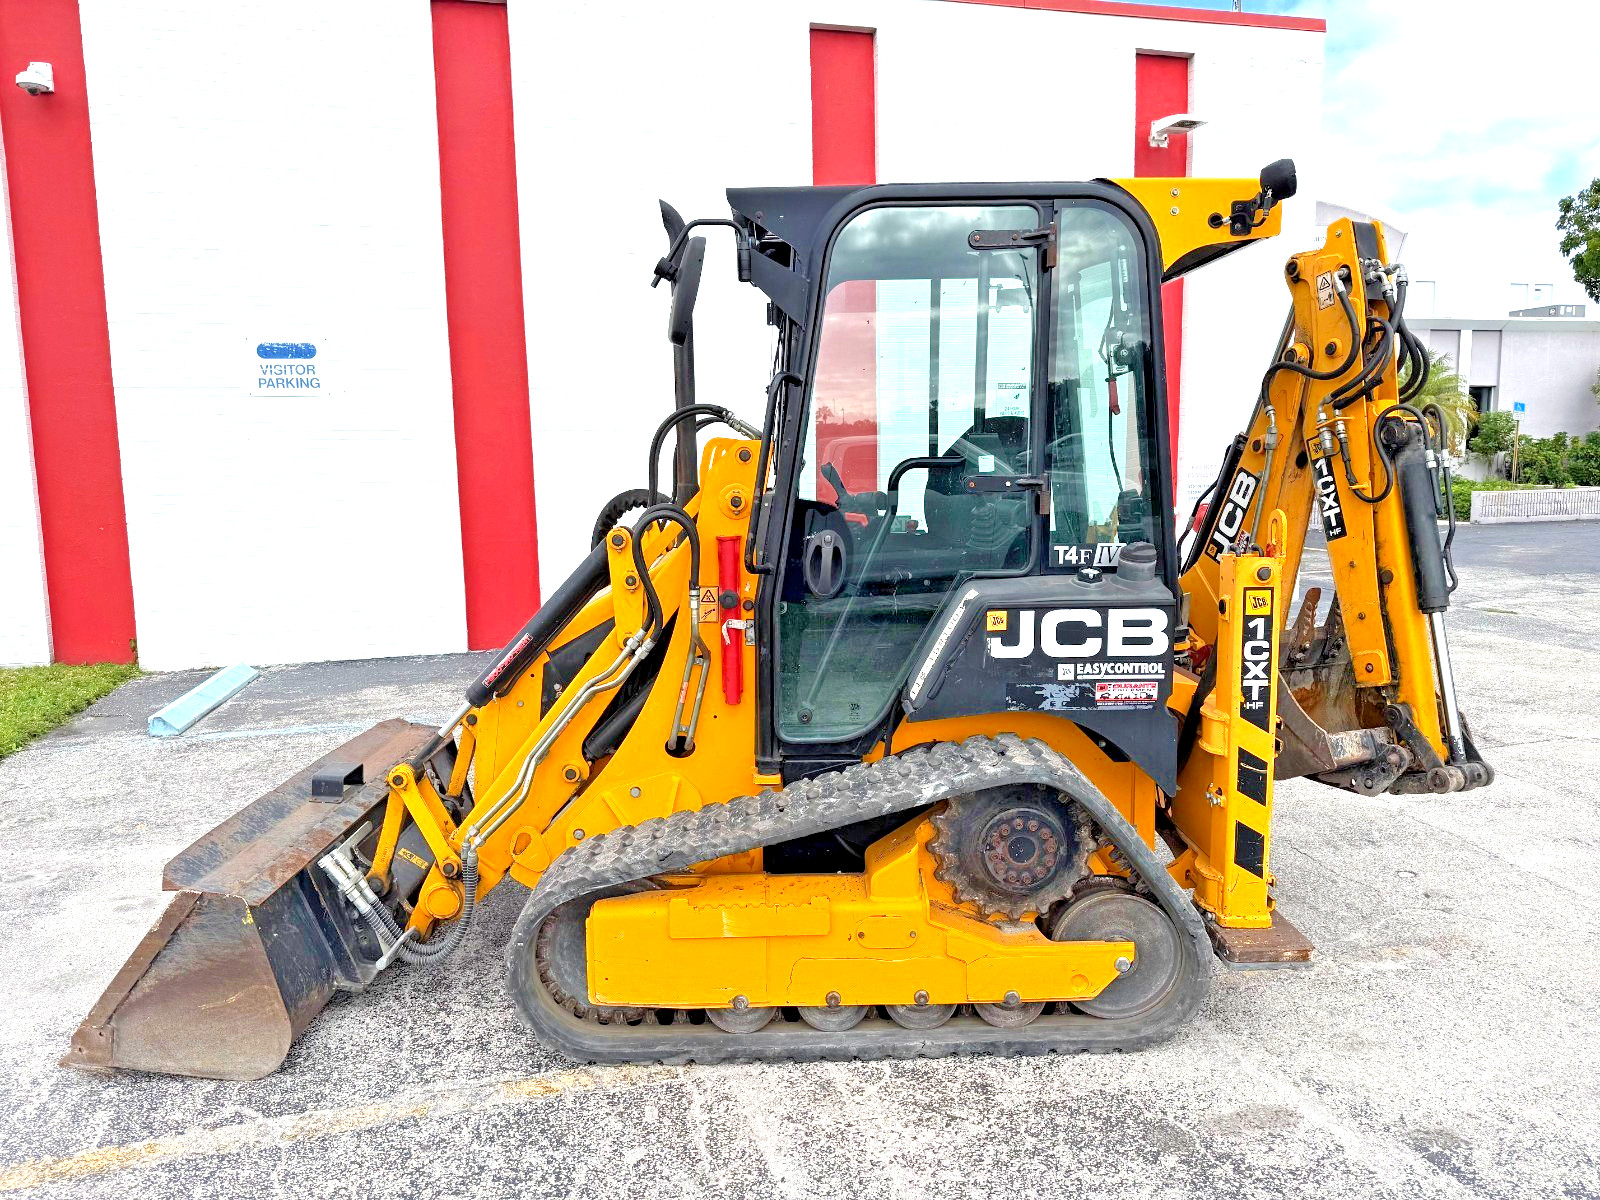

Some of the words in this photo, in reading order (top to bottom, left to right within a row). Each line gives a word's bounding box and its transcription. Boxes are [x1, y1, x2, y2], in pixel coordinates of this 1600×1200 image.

[259, 364, 316, 376] VISITOR
[258, 377, 320, 389] PARKING
[1212, 471, 1257, 562] JCB
[1329, 527, 1342, 537] HF
[1250, 595, 1269, 609] JCB
[987, 608, 1170, 658] JCB
[1243, 617, 1270, 701] 1CXT
[1245, 701, 1264, 710] HF
